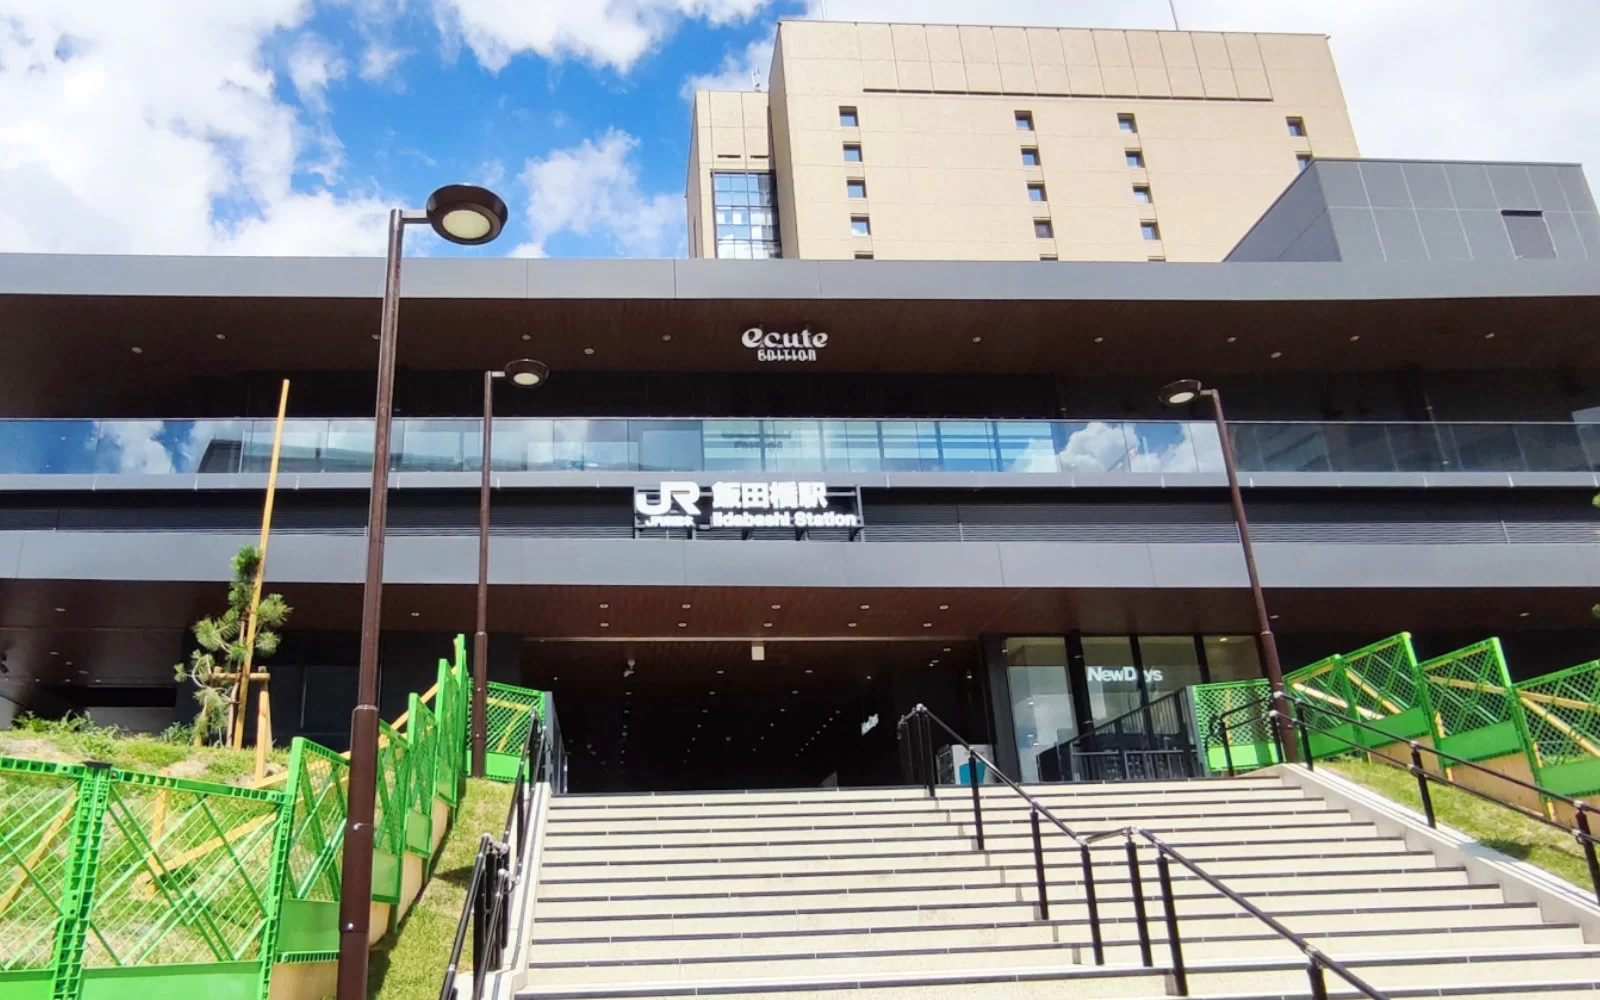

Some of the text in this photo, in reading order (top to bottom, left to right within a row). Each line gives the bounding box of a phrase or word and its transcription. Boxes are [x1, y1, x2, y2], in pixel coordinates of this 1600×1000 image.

[635, 481, 701, 515] JR
[712, 511, 858, 527] Iidabashi Station
[1087, 666, 1164, 683] NewDys
